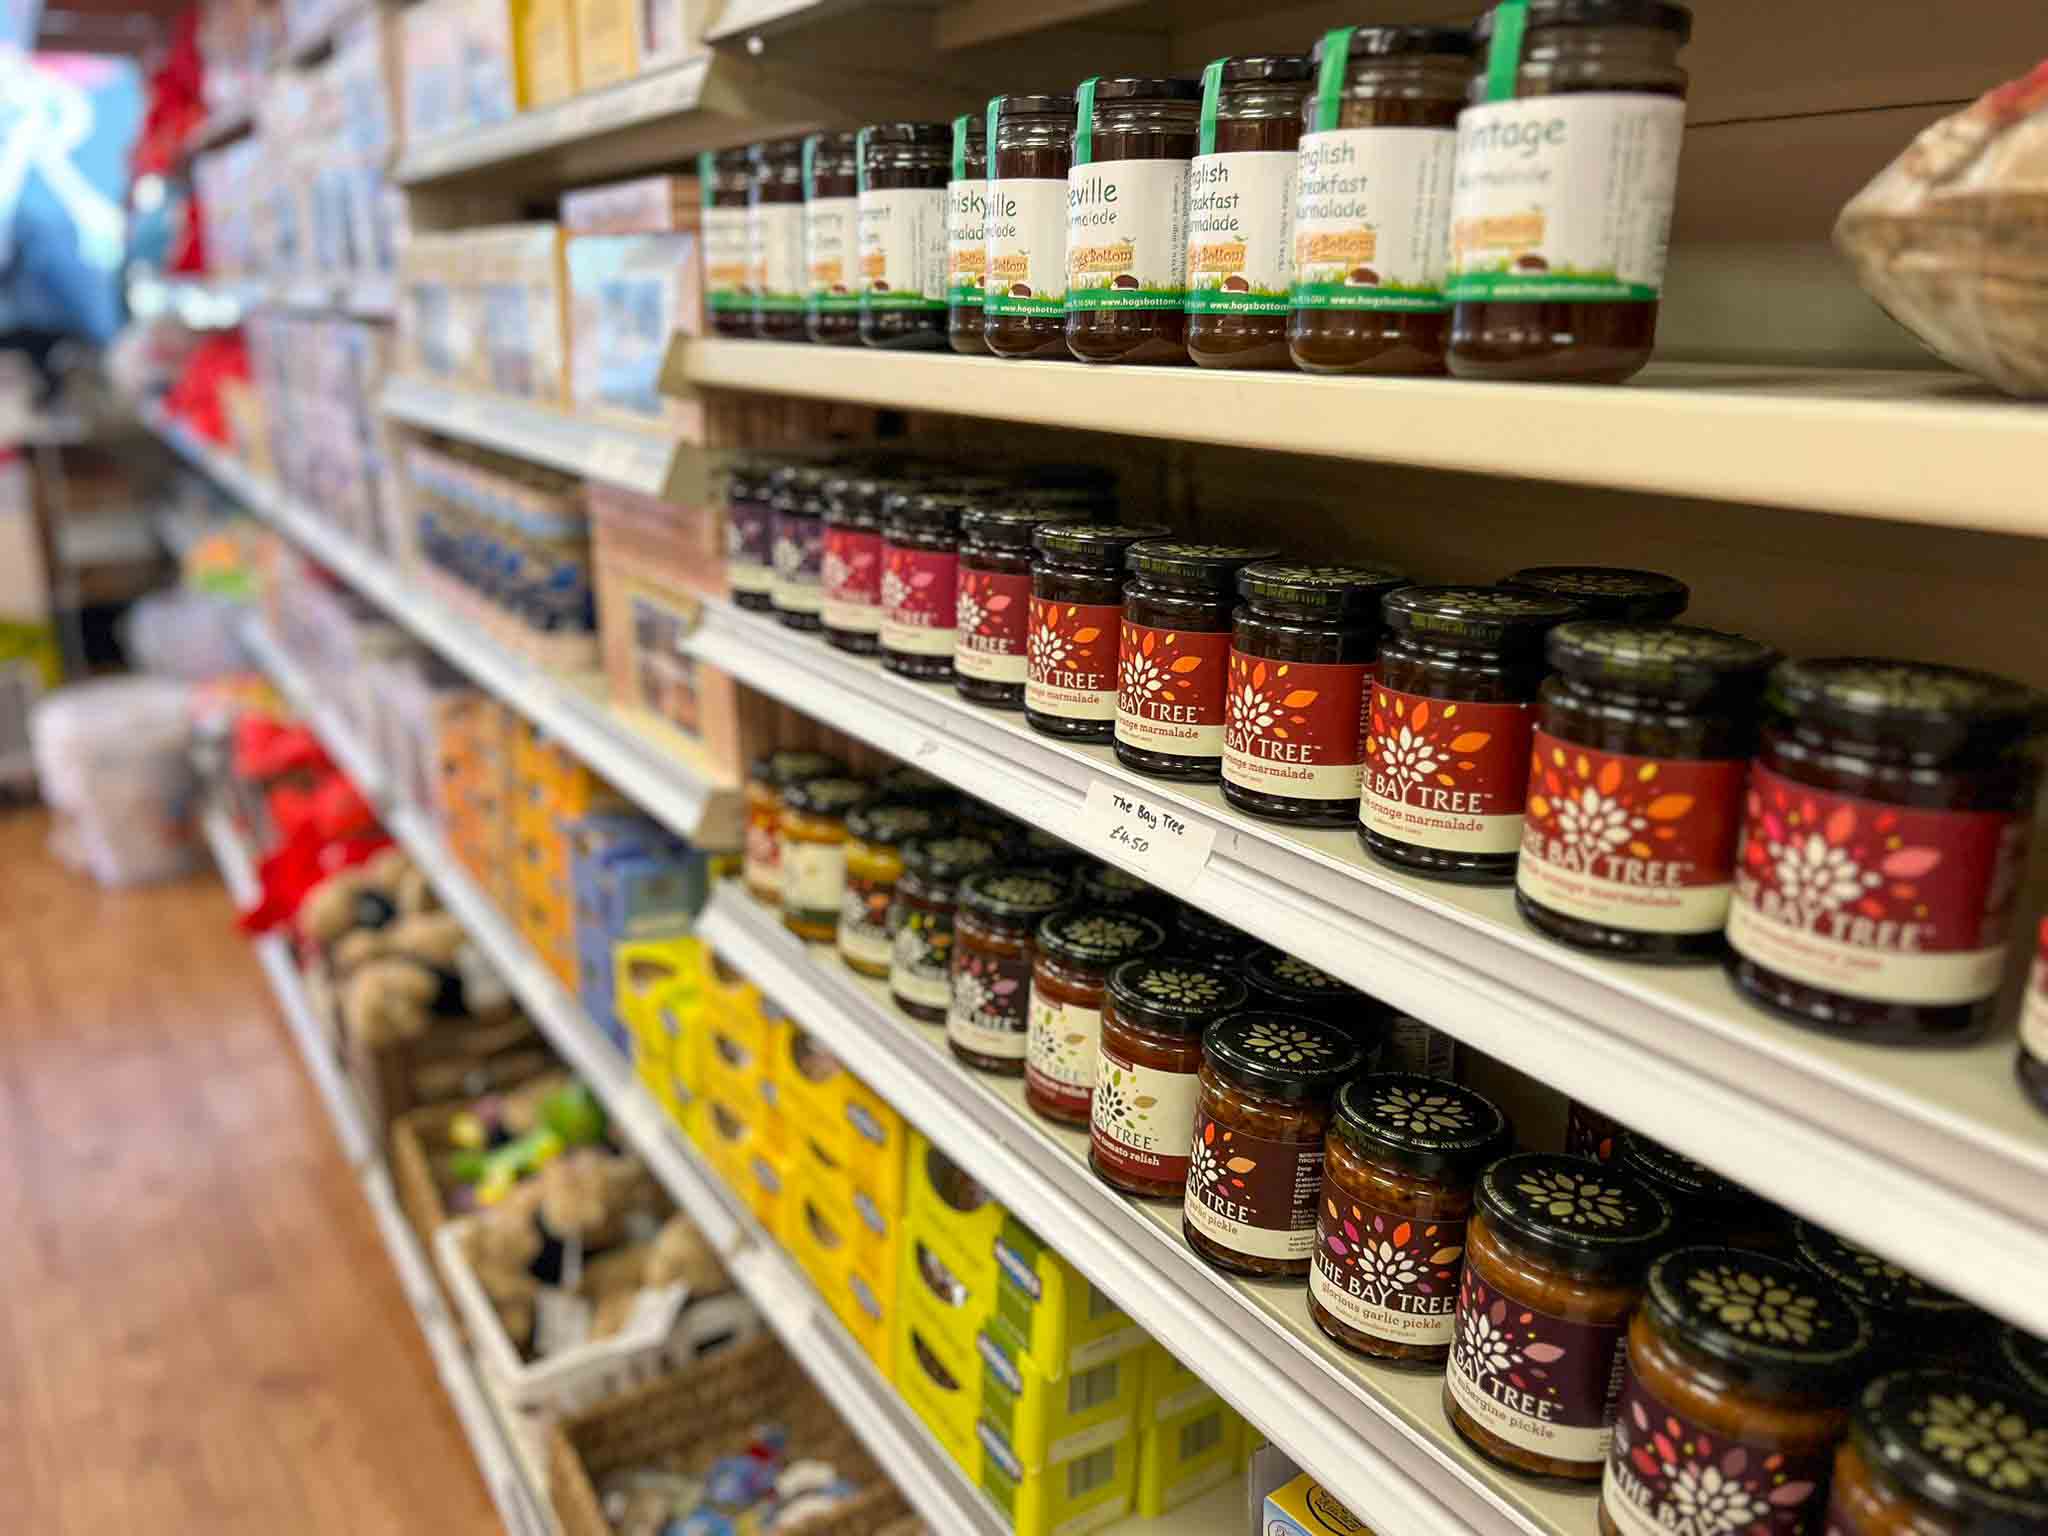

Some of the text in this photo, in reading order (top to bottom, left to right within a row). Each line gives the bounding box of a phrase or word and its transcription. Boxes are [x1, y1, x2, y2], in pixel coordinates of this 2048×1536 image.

[1053, 670, 1100, 690] TREE
[1148, 701, 1201, 724] TREE
[1140, 723, 1200, 740] marmalade
[1258, 739, 1314, 763] TREE
[1249, 760, 1315, 780] marmalade
[1375, 771, 1413, 807] BAY
[1417, 786, 1484, 814] TREE
[1112, 794, 1185, 836] The Bay Tree
[1404, 812, 1484, 833] marmalade
[1109, 825, 1150, 852] £4.50
[1111, 1124, 1153, 1151] TREE
[1129, 1149, 1161, 1167] relish
[1204, 1188, 1249, 1224] TREE
[1207, 1214, 1238, 1234] pickle
[1318, 1249, 1454, 1314] THE BAY TREE
[1361, 1309, 1400, 1326] garlic
[1402, 1314, 1441, 1330] pickle
[1489, 1376, 1551, 1422] TREE
